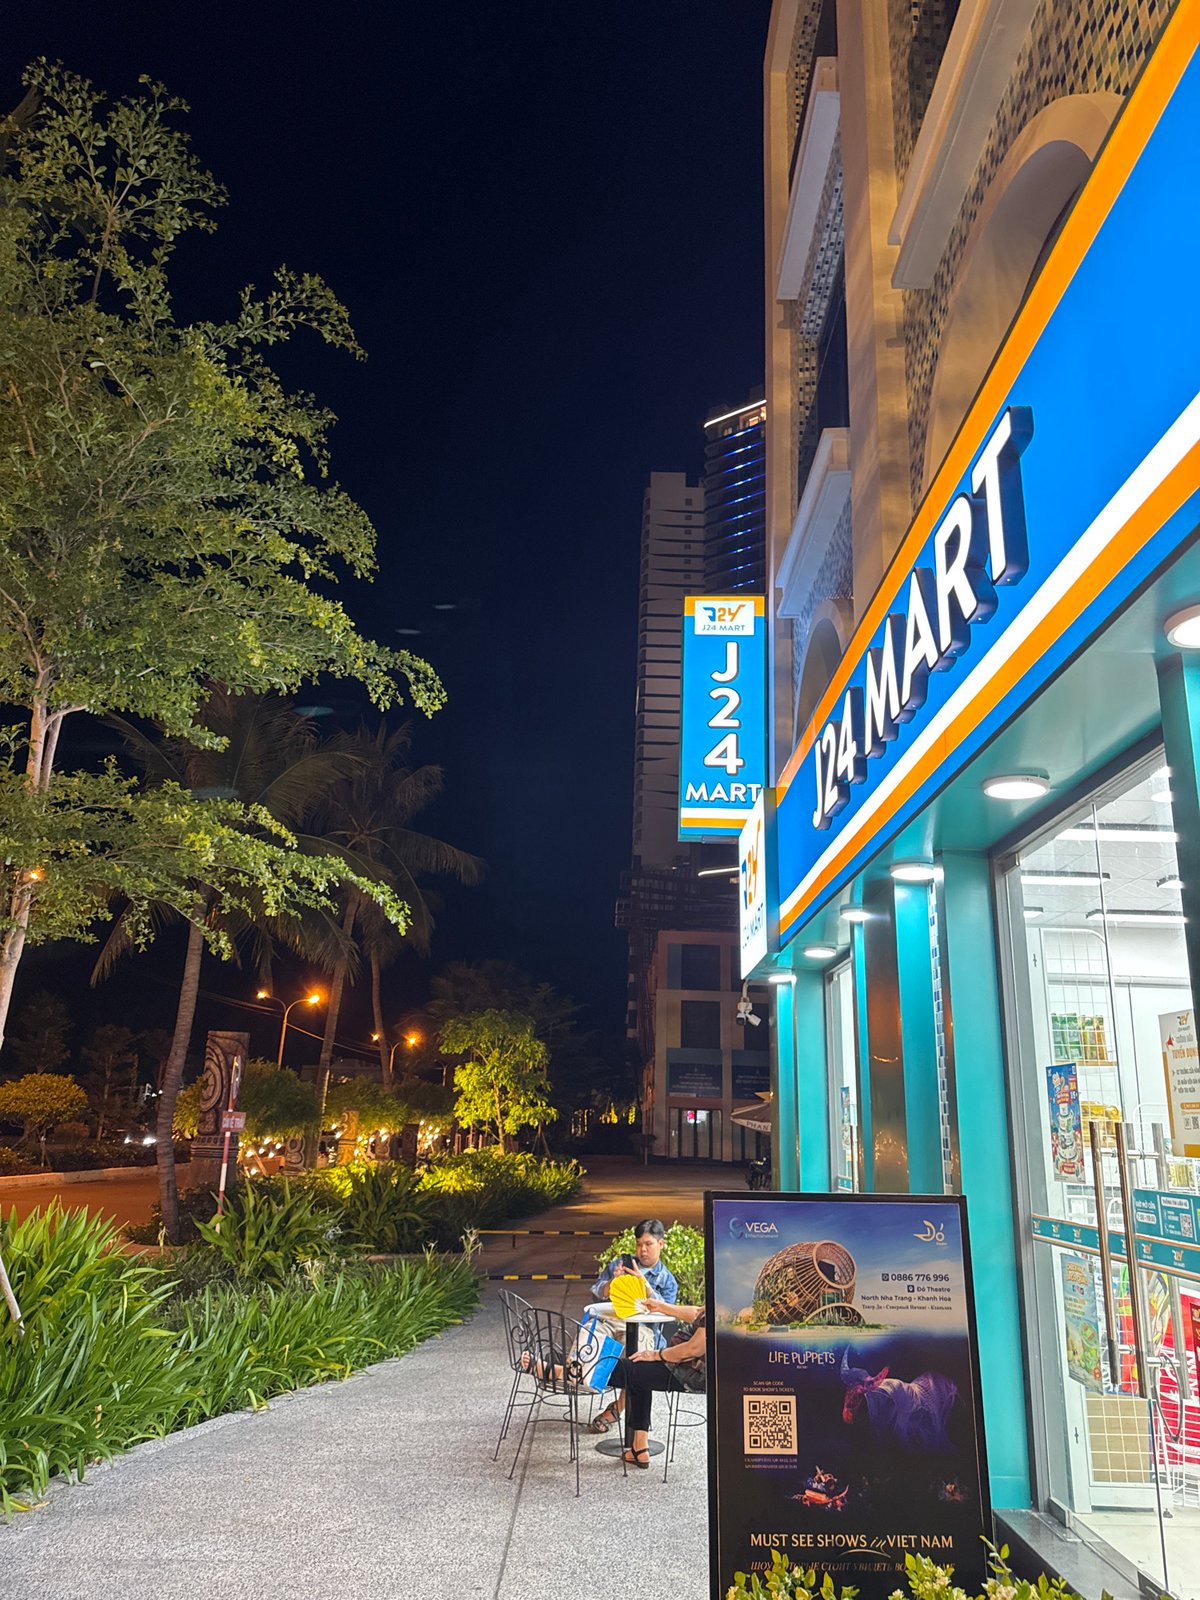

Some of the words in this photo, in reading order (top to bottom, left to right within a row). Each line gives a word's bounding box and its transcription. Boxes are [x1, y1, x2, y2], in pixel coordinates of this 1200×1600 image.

[812, 689, 860, 829] J24
[864, 407, 1014, 758] MART
[702, 624, 717, 632] J24
[719, 624, 746, 632] MART
[685, 782, 762, 803] MART
[745, 1222, 778, 1233] VEGA
[891, 1273, 913, 1281] 0886
[933, 1274, 950, 1282] 996
[895, 1295, 912, 1303] Trang
[768, 1351, 790, 1365] LIFE
[791, 1351, 836, 1365] PUPPETS
[750, 1533, 788, 1547] MUST
[791, 1534, 814, 1547] SEE
[817, 1534, 867, 1548] SHOWS
[870, 1536, 888, 1553] in
[886, 1535, 917, 1548] VIET
[921, 1535, 954, 1548] NAM
